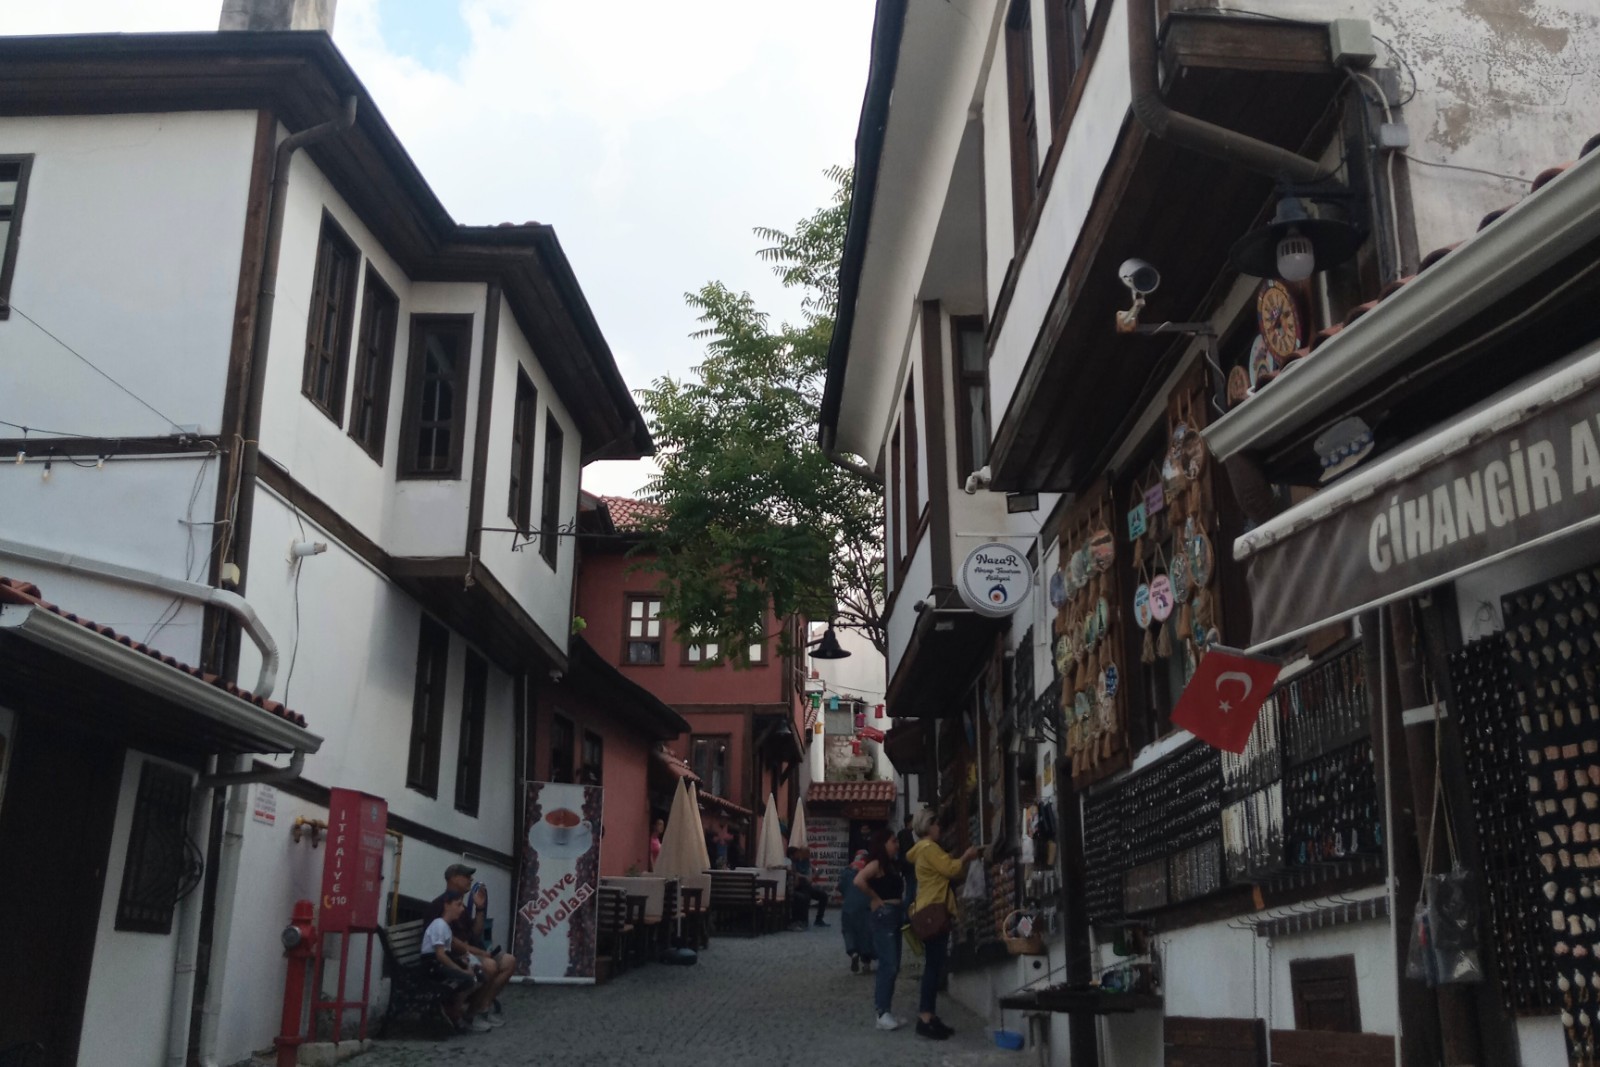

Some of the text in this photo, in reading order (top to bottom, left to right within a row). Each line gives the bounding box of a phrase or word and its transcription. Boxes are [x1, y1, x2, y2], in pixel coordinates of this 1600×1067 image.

[1368, 413, 1600, 574] CİHANGİR A
[975, 553, 1018, 567] NazaR
[331, 896, 347, 905] 110
[520, 872, 576, 922] Kahve
[535, 883, 594, 937] Molası
